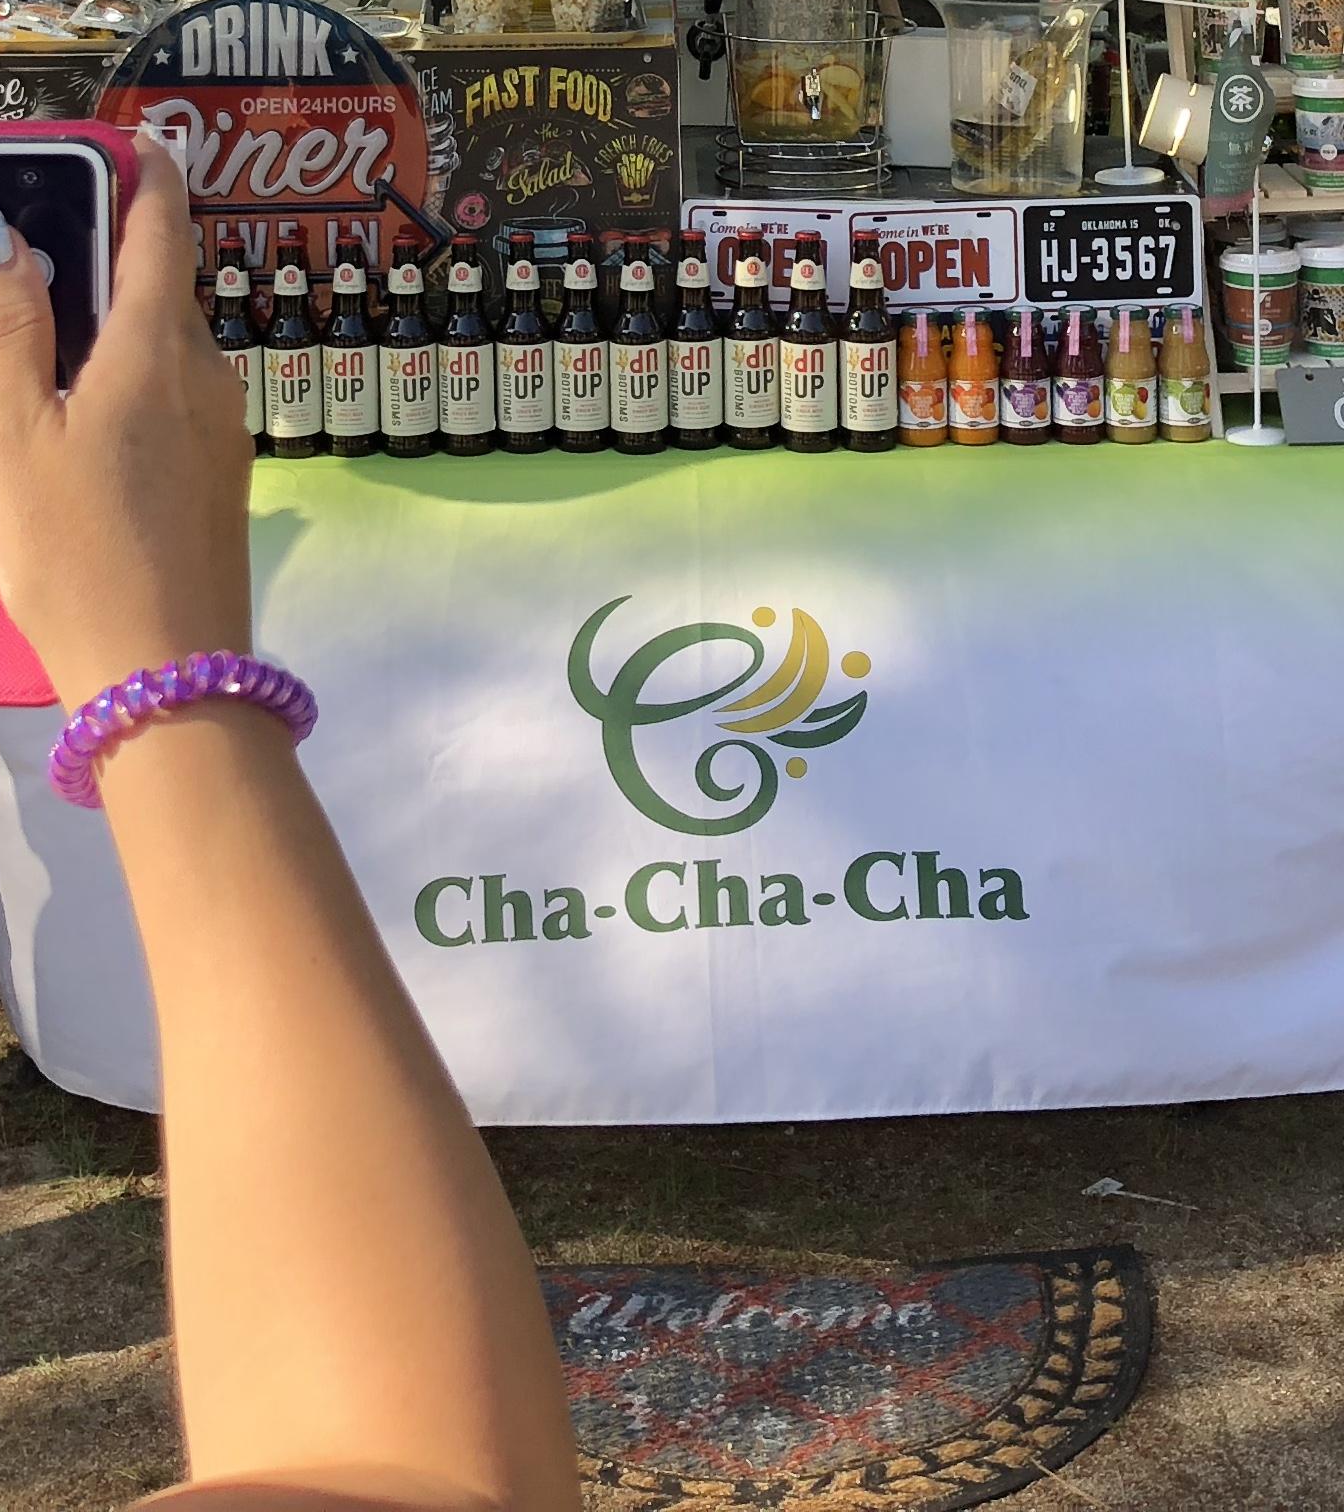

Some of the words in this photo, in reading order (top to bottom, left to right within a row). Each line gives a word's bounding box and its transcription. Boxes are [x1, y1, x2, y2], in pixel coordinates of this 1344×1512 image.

[182, 2, 334, 77] DRINK
[240, 97, 298, 115] OPEN
[464, 66, 540, 128] FAST
[548, 67, 613, 123] FOOD
[1228, 85, 1254, 113] 茶
[594, 136, 637, 168] FRENCH
[641, 134, 673, 164] FRIES
[507, 150, 574, 205] Salad
[906, 225, 919, 238] in
[921, 223, 950, 236] WE'RE
[1082, 220, 1127, 231] OKLAHOMA
[1129, 220, 1139, 229] IS
[1158, 218, 1171, 228] OK
[879, 238, 990, 291] OPEN
[1040, 235, 1176, 283] HJ-3567
[281, 379, 311, 404] UP
[335, 378, 364, 402] UP
[402, 377, 432, 403] UP
[450, 375, 480, 402] UP
[514, 374, 544, 400] UP
[574, 373, 602, 399] UP
[630, 374, 659, 400] UP
[681, 371, 711, 397] UP
[747, 369, 775, 396] UP
[795, 374, 824, 399] UP
[861, 372, 890, 399] UP
[414, 849, 1030, 948] Cha-Cha-Cha
